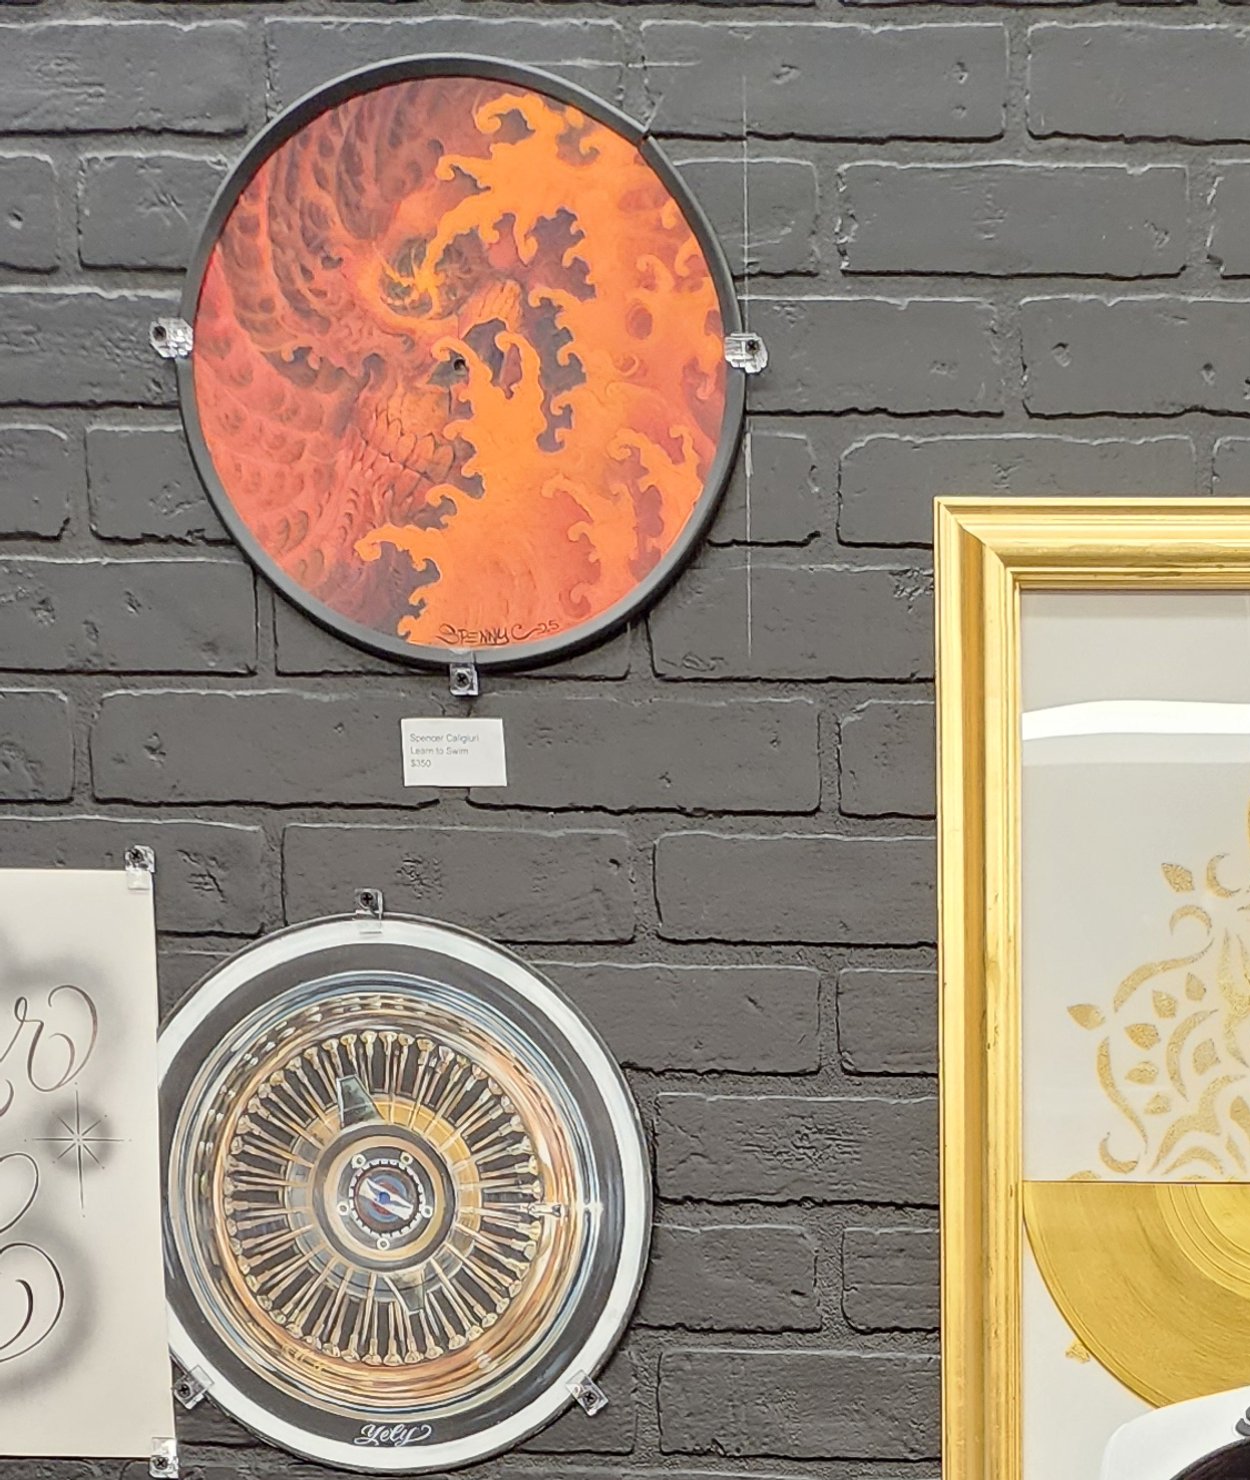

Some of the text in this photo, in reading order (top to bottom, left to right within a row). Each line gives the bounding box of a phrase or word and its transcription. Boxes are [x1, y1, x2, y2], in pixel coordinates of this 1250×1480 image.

[409, 733, 444, 743] Spencer
[410, 746, 469, 755] Learn to Swim
